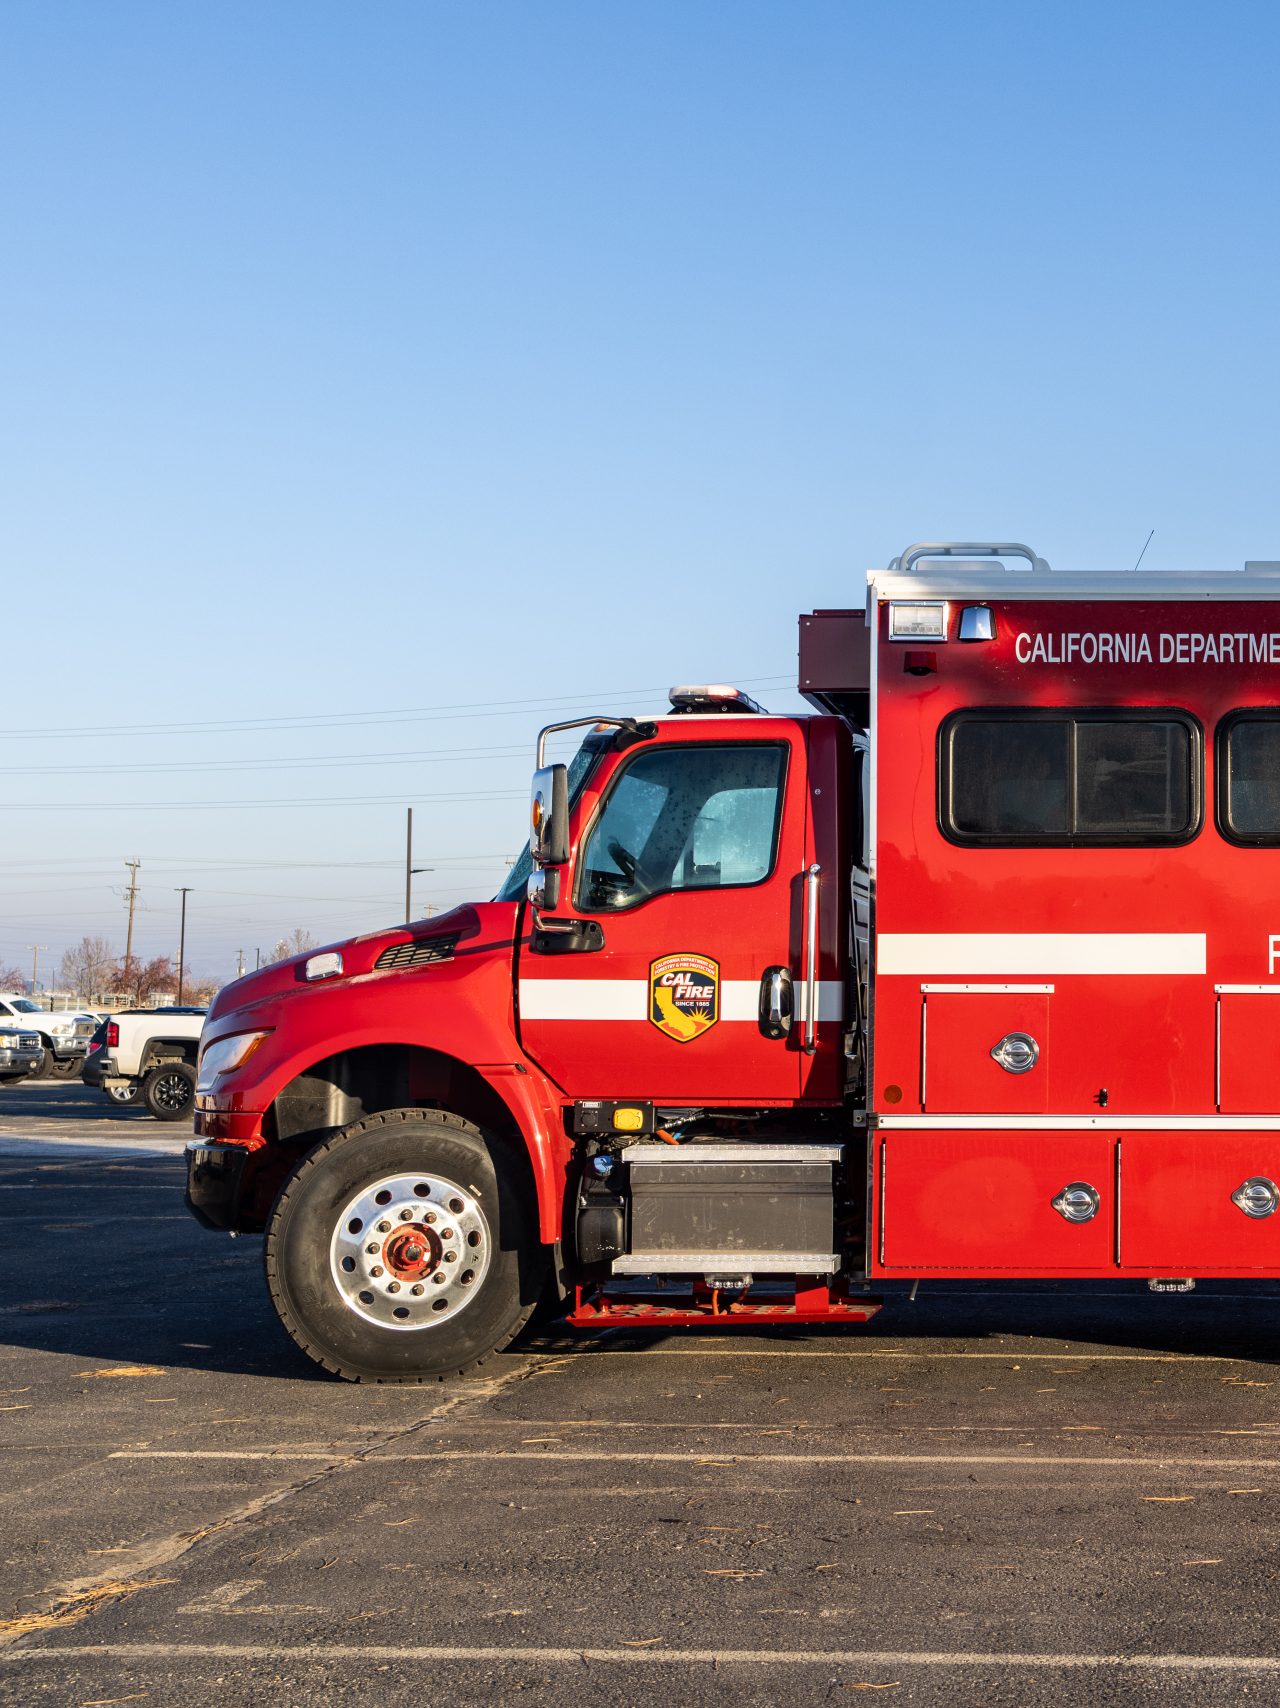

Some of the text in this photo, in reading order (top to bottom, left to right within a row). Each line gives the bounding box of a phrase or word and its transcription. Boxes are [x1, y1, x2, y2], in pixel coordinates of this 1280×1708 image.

[1015, 632, 1153, 664] CALIFORNIA
[654, 963, 675, 975] FORESTRY
[689, 962, 715, 975] PROTECTION
[655, 957, 680, 969] CALIFORNIA
[680, 957, 709, 967] DEPARTMENT
[661, 972, 694, 986] CAL
[675, 985, 714, 999] FIRE
